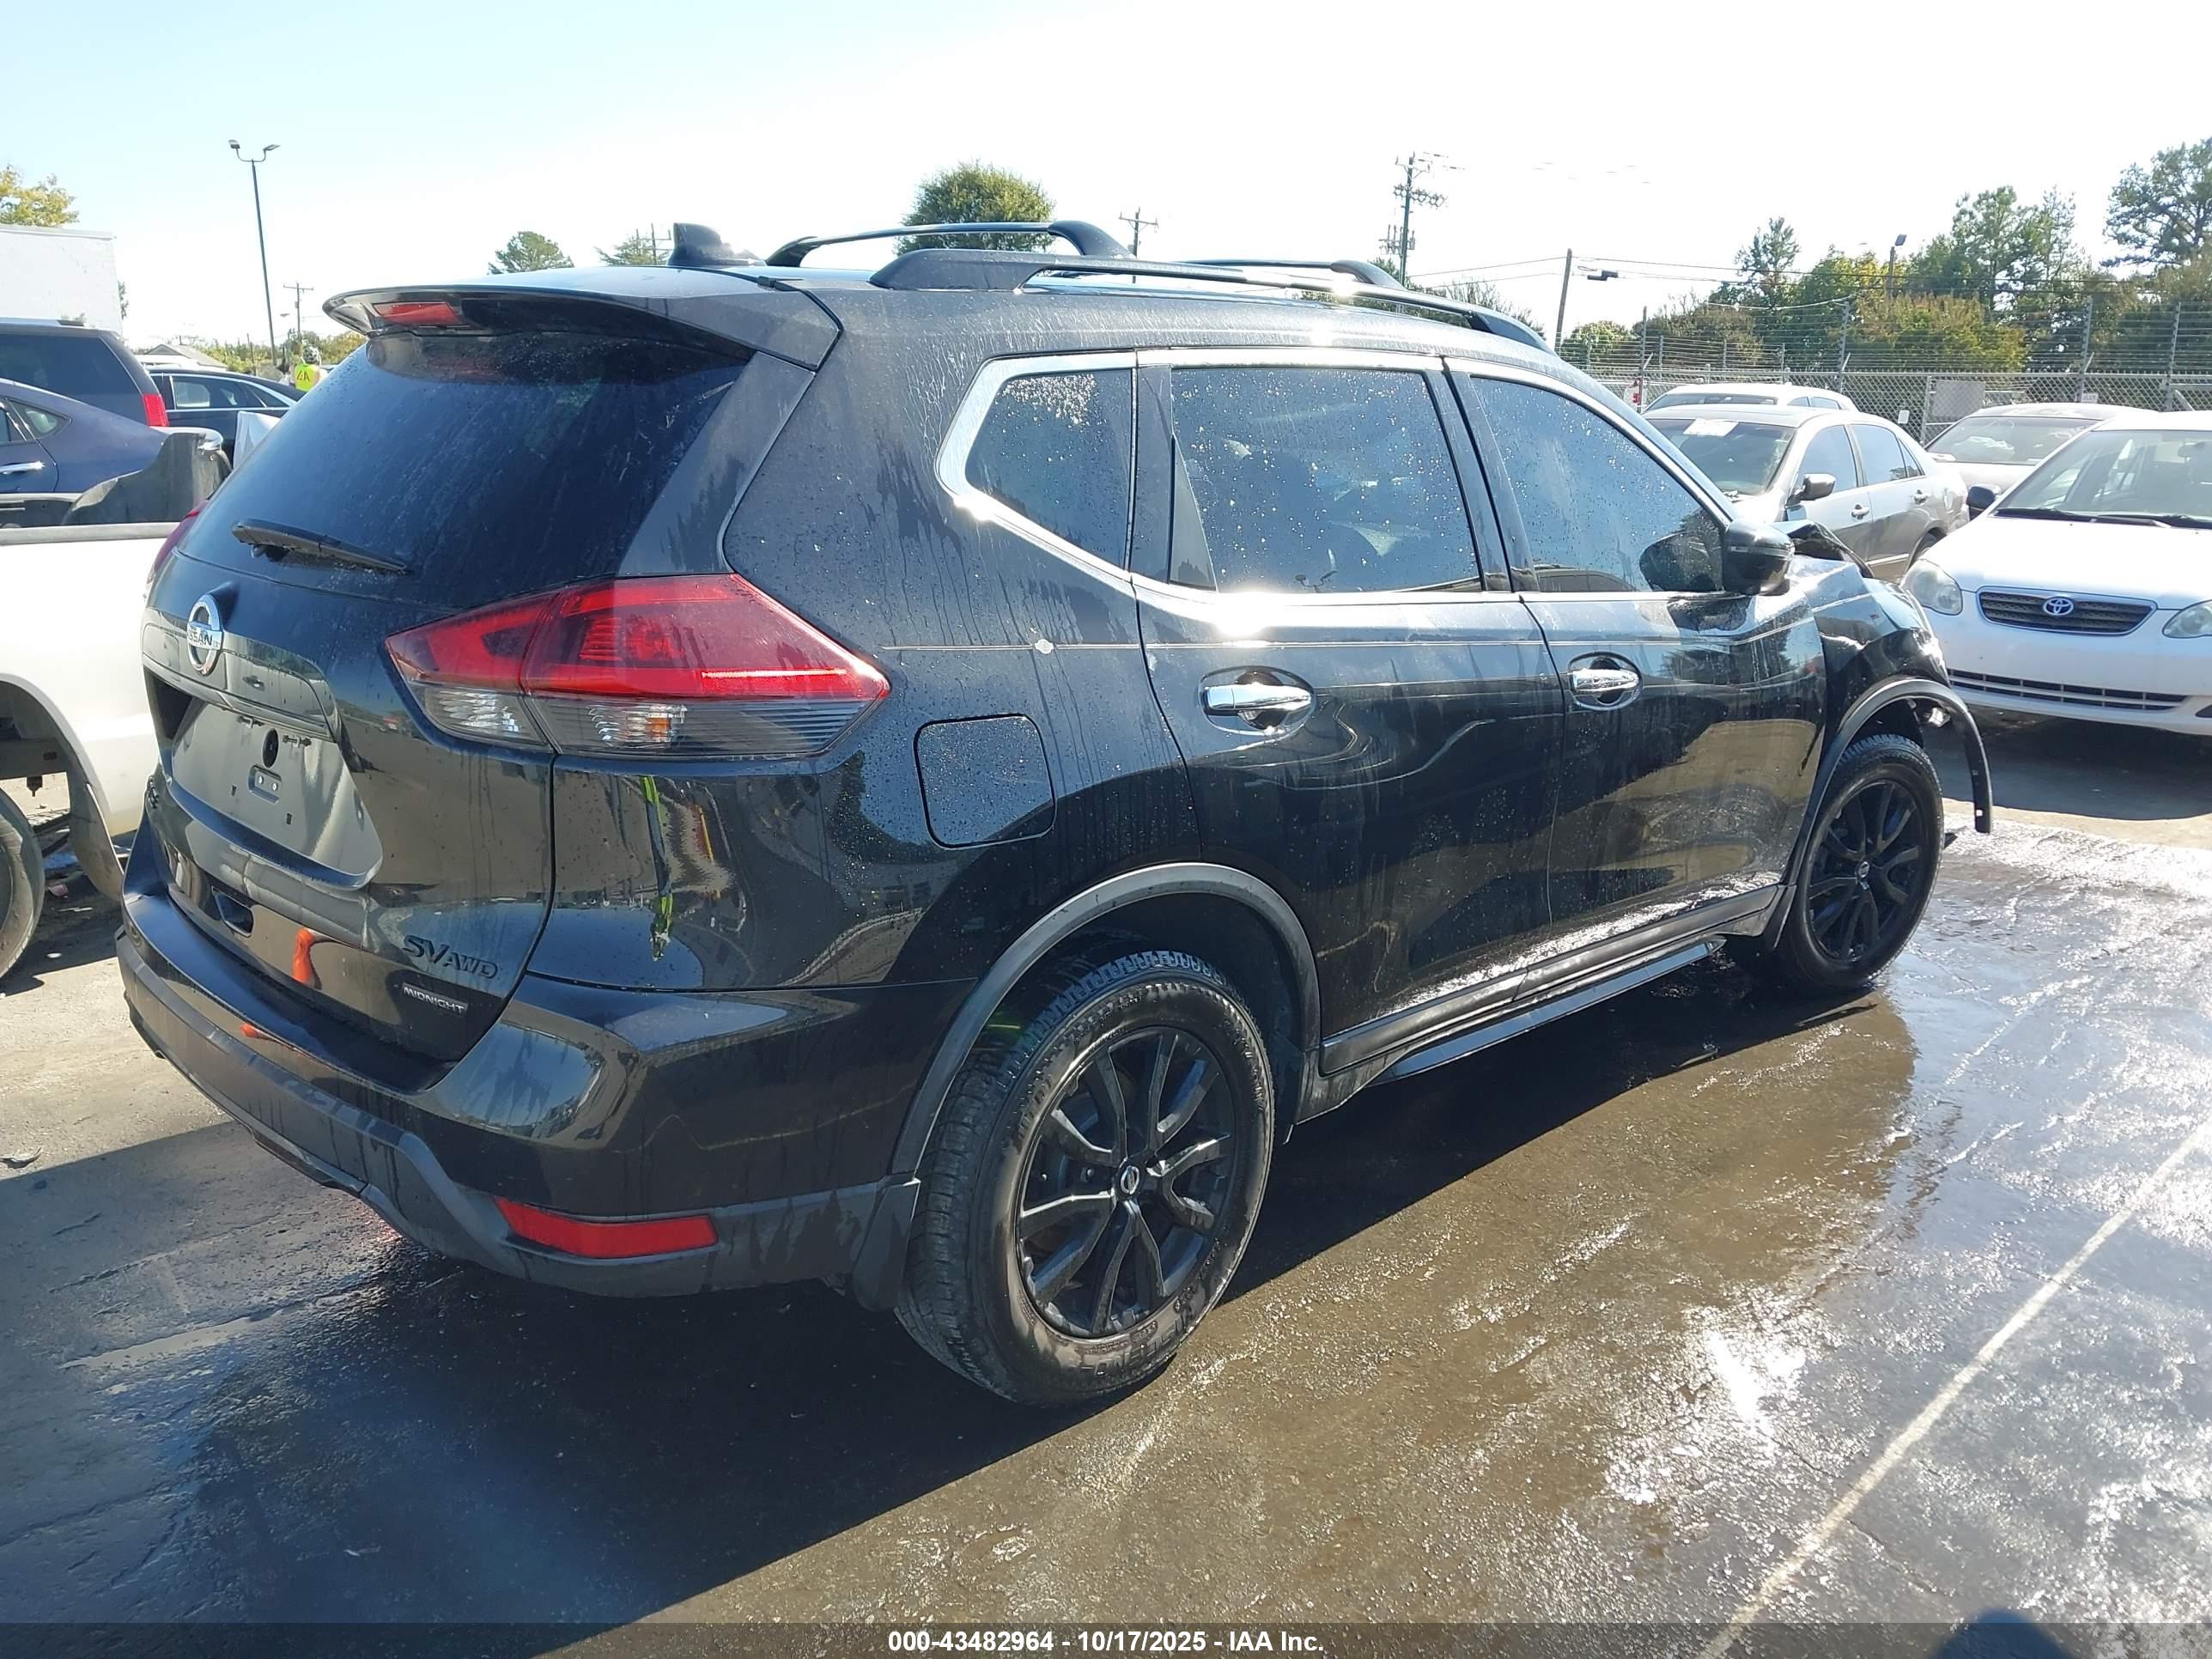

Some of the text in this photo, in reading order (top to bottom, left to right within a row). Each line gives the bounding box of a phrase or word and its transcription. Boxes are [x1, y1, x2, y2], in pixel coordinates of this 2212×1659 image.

[187, 629, 213, 646] SSAN
[402, 934, 498, 979] SV AWD
[403, 986, 465, 1014] MIDNIGHT
